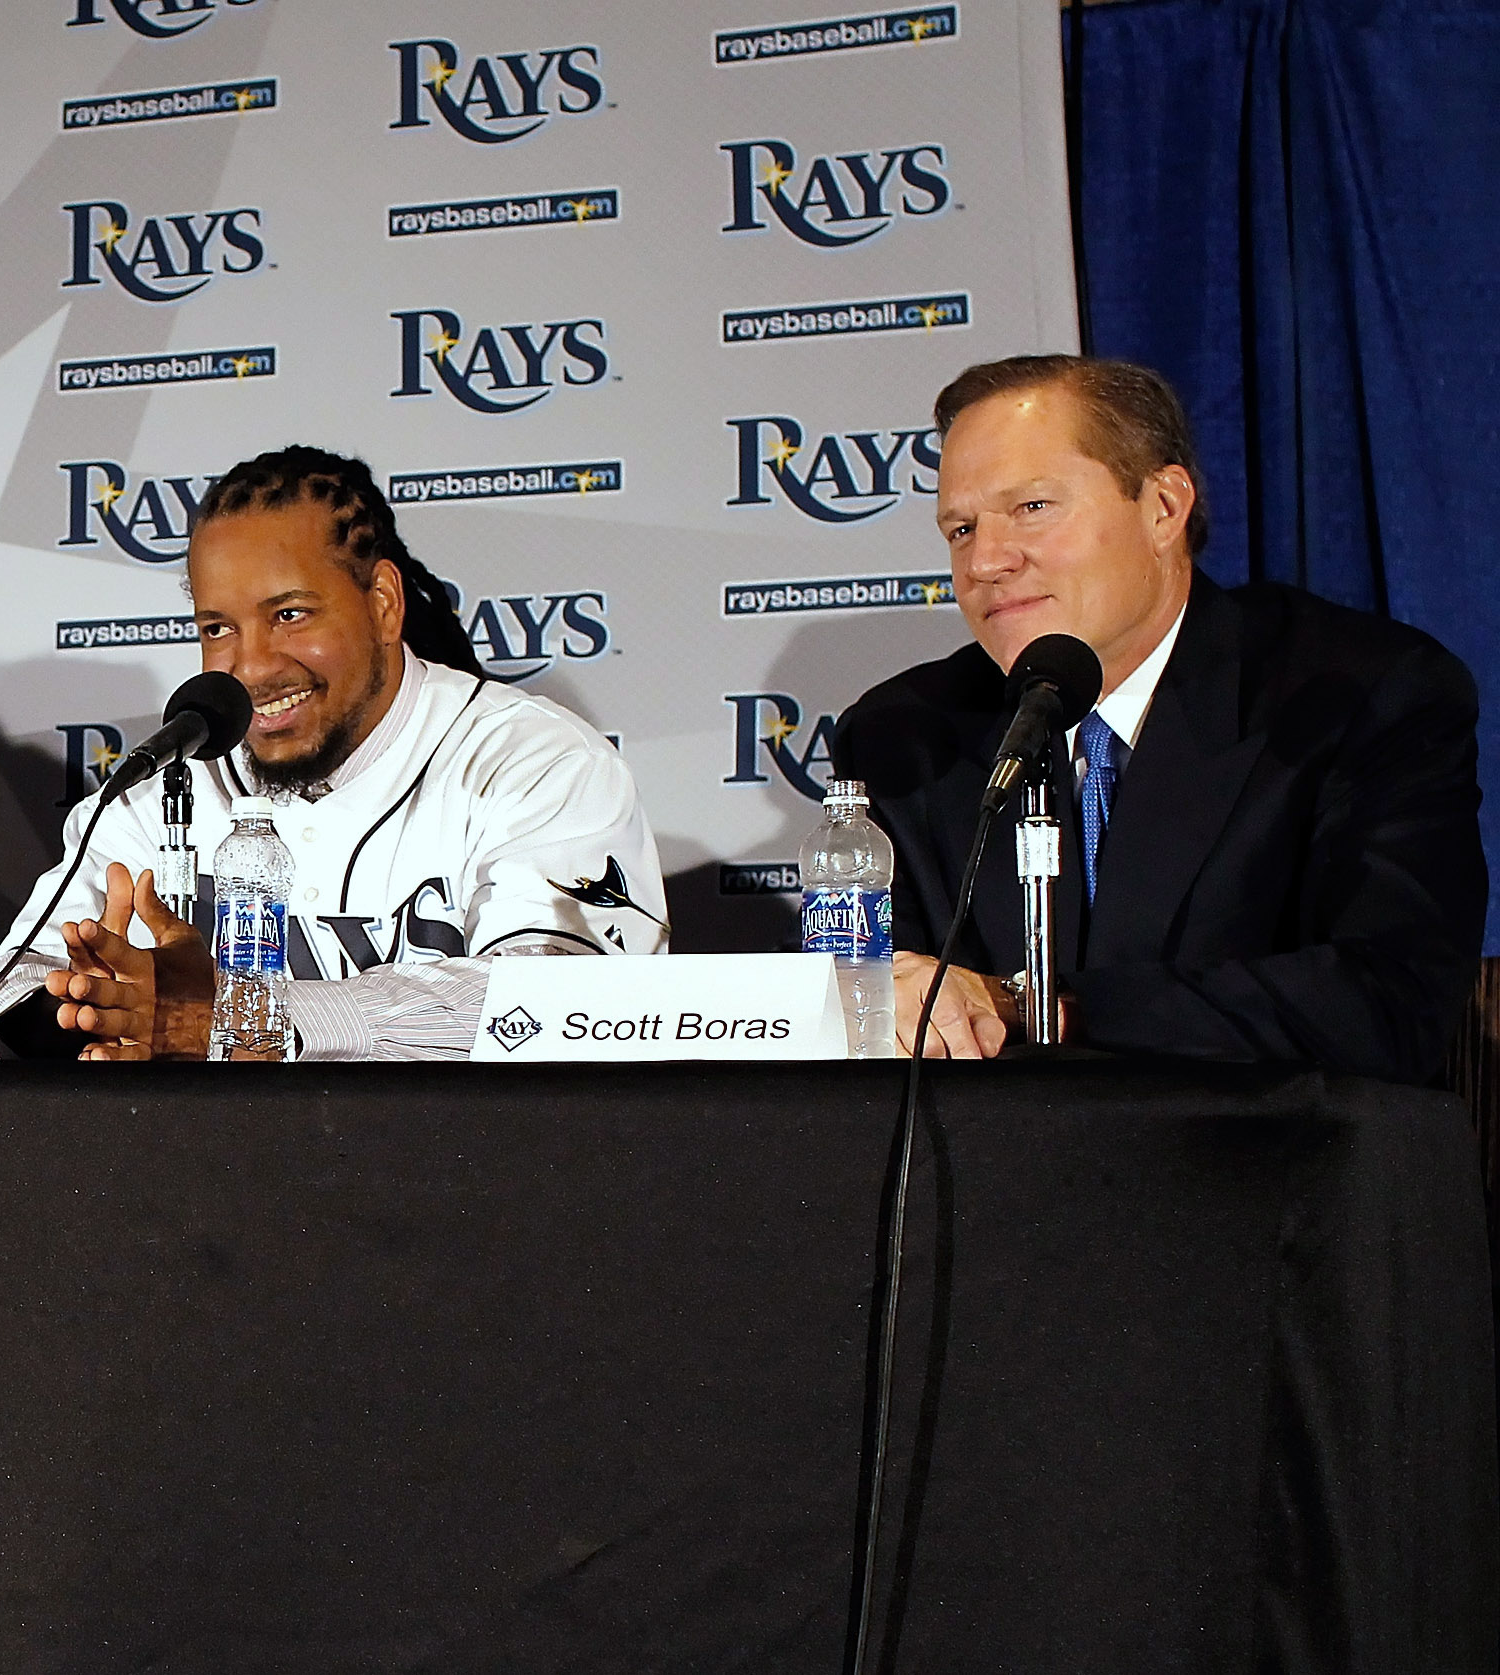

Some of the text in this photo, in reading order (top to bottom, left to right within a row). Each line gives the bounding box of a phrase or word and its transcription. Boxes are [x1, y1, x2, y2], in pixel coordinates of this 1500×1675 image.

[389, 39, 602, 143] RAYS
[720, 141, 948, 247] RAYS
[62, 201, 263, 301] RAYS
[390, 309, 607, 413] RAYS
[59, 461, 227, 563] RAY
[59, 622, 199, 647] raysbaseba
[445, 580, 607, 684] AYS
[724, 694, 837, 803] RA
[562, 1012, 791, 1041] Scott Boras
